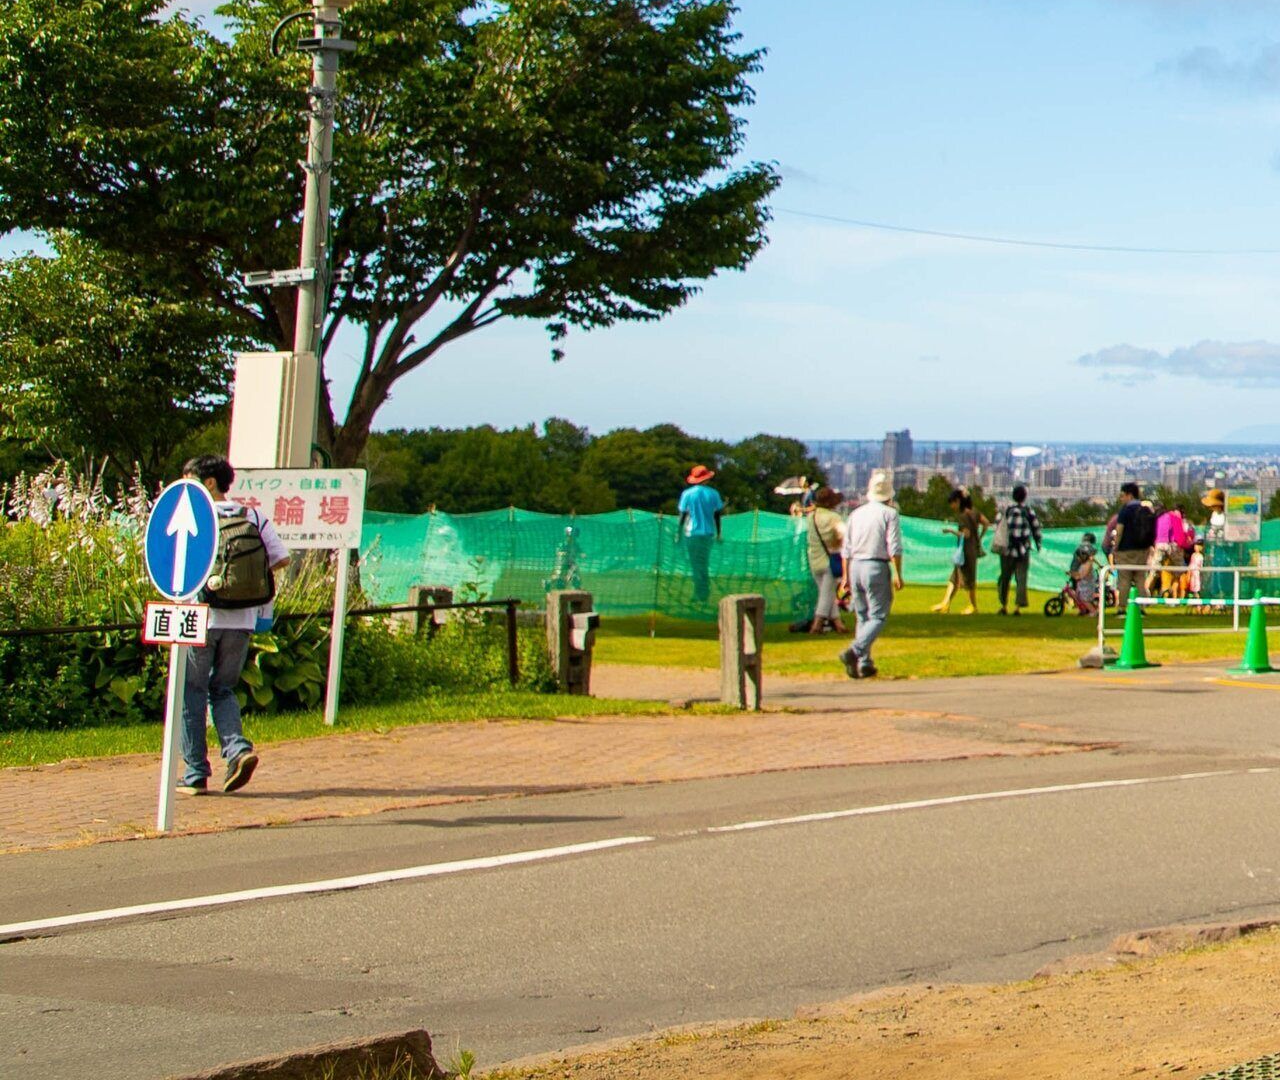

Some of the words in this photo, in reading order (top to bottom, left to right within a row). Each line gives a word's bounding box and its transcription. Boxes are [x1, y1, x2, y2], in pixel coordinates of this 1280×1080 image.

[239, 478, 342, 491] バイク・自転車
[153, 608, 198, 638] 直進
